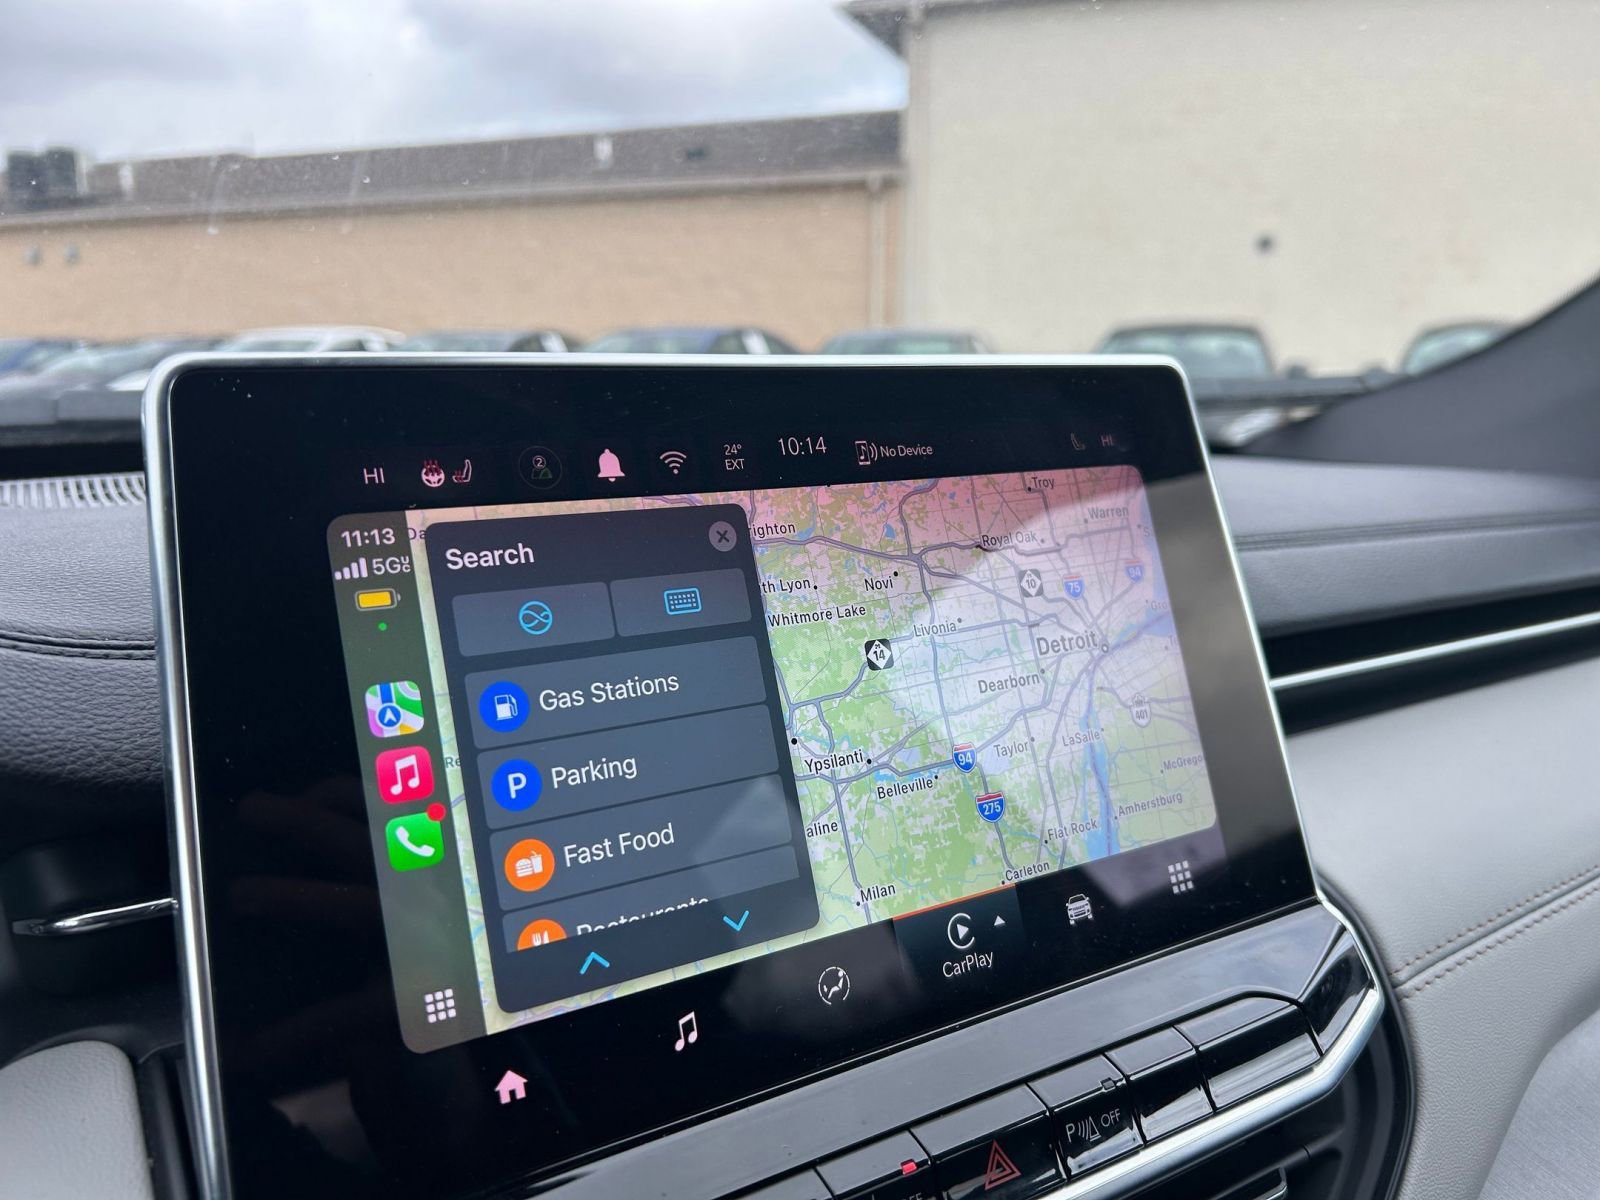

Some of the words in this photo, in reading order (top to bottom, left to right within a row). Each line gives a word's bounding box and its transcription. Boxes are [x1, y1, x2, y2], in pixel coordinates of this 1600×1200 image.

[778, 437, 827, 456] 10:14
[880, 446, 897, 457] No
[898, 444, 933, 456] Device
[725, 459, 745, 470] EXT
[363, 468, 385, 484] HI
[1031, 476, 1055, 490] Troy
[1087, 505, 1129, 520] Warren
[341, 528, 396, 548] 11:13
[747, 523, 796, 539] ighton
[981, 533, 1013, 547] Royal
[1015, 531, 1037, 544] Oak
[445, 542, 535, 570] Search
[779, 579, 811, 594] Lyon
[865, 576, 893, 591] Novi
[1026, 579, 1036, 589] 10
[1069, 582, 1081, 593] 75
[768, 610, 833, 627] Whitmore
[836, 605, 867, 619] Lake
[913, 621, 957, 637] Livonia
[1036, 630, 1098, 656] Detroit
[873, 649, 885, 661] 14
[978, 672, 1040, 694] Dearborn
[539, 689, 584, 711] Gas
[590, 674, 680, 703] Stations
[1135, 709, 1149, 720] 401
[1062, 730, 1100, 747] LaSalle
[994, 741, 1028, 758] Taylor
[804, 749, 864, 775] Ypsilanti
[958, 752, 973, 765] 94
[551, 757, 637, 789] Parking
[507, 772, 527, 799] P
[877, 778, 933, 800] Belleville
[983, 802, 1001, 816] 275
[1118, 792, 1183, 817] Amherstburg
[1047, 827, 1068, 841] Flat
[1070, 818, 1098, 835] Rock
[564, 838, 613, 867] Fast
[619, 823, 675, 855] Food
[1005, 861, 1050, 883] Carleton
[860, 884, 896, 902] Milan
[942, 951, 993, 978] CarPlay
[1065, 1123, 1075, 1143] P
[1100, 1109, 1121, 1128] OFF
